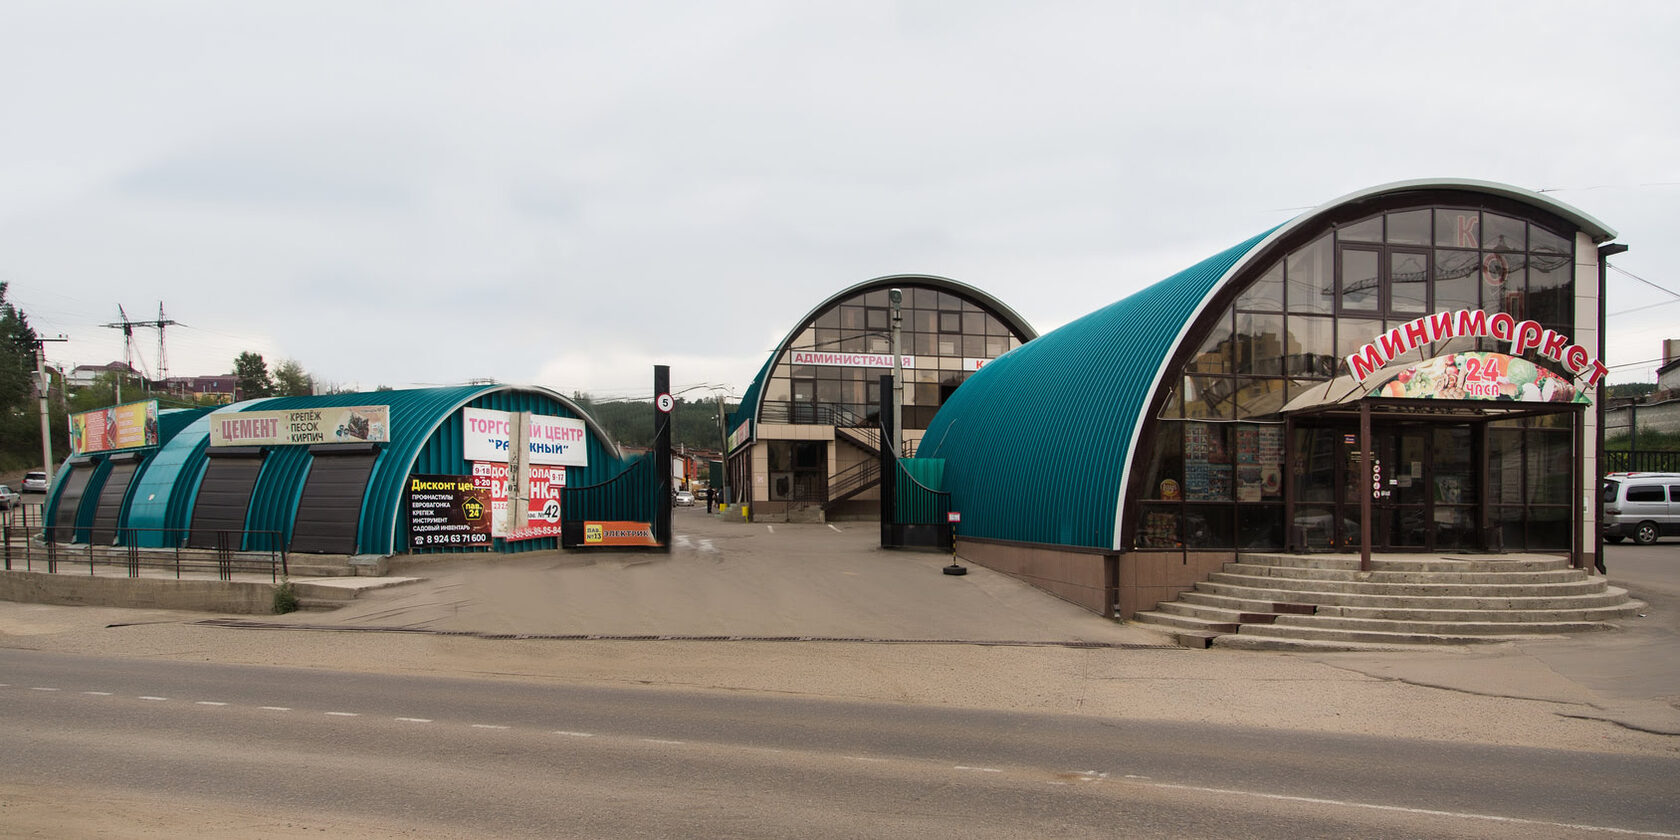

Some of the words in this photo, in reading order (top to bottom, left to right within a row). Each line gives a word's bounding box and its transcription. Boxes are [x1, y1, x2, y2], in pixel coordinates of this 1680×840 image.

[794, 353, 911, 367] АДМИНИСТРАЦЯ
[1466, 358, 1500, 383] 24
[1466, 384, 1500, 396] ЧАСА
[662, 398, 669, 407] 5
[290, 411, 322, 421] КРЕПЁЖ
[221, 418, 279, 442] ЦЕМЕНТ
[290, 422, 319, 432] ПЕСОК
[469, 418, 542, 438] ТОРГОЙ
[545, 425, 584, 442] ЦЕНТР
[291, 432, 324, 443] КИРПИЧ
[411, 479, 456, 491] Дисконт
[491, 480, 560, 499] ВАНКА
[544, 504, 559, 518] 42
[426, 535, 432, 543] 8
[434, 535, 449, 543] 924
[471, 534, 486, 542] 600
